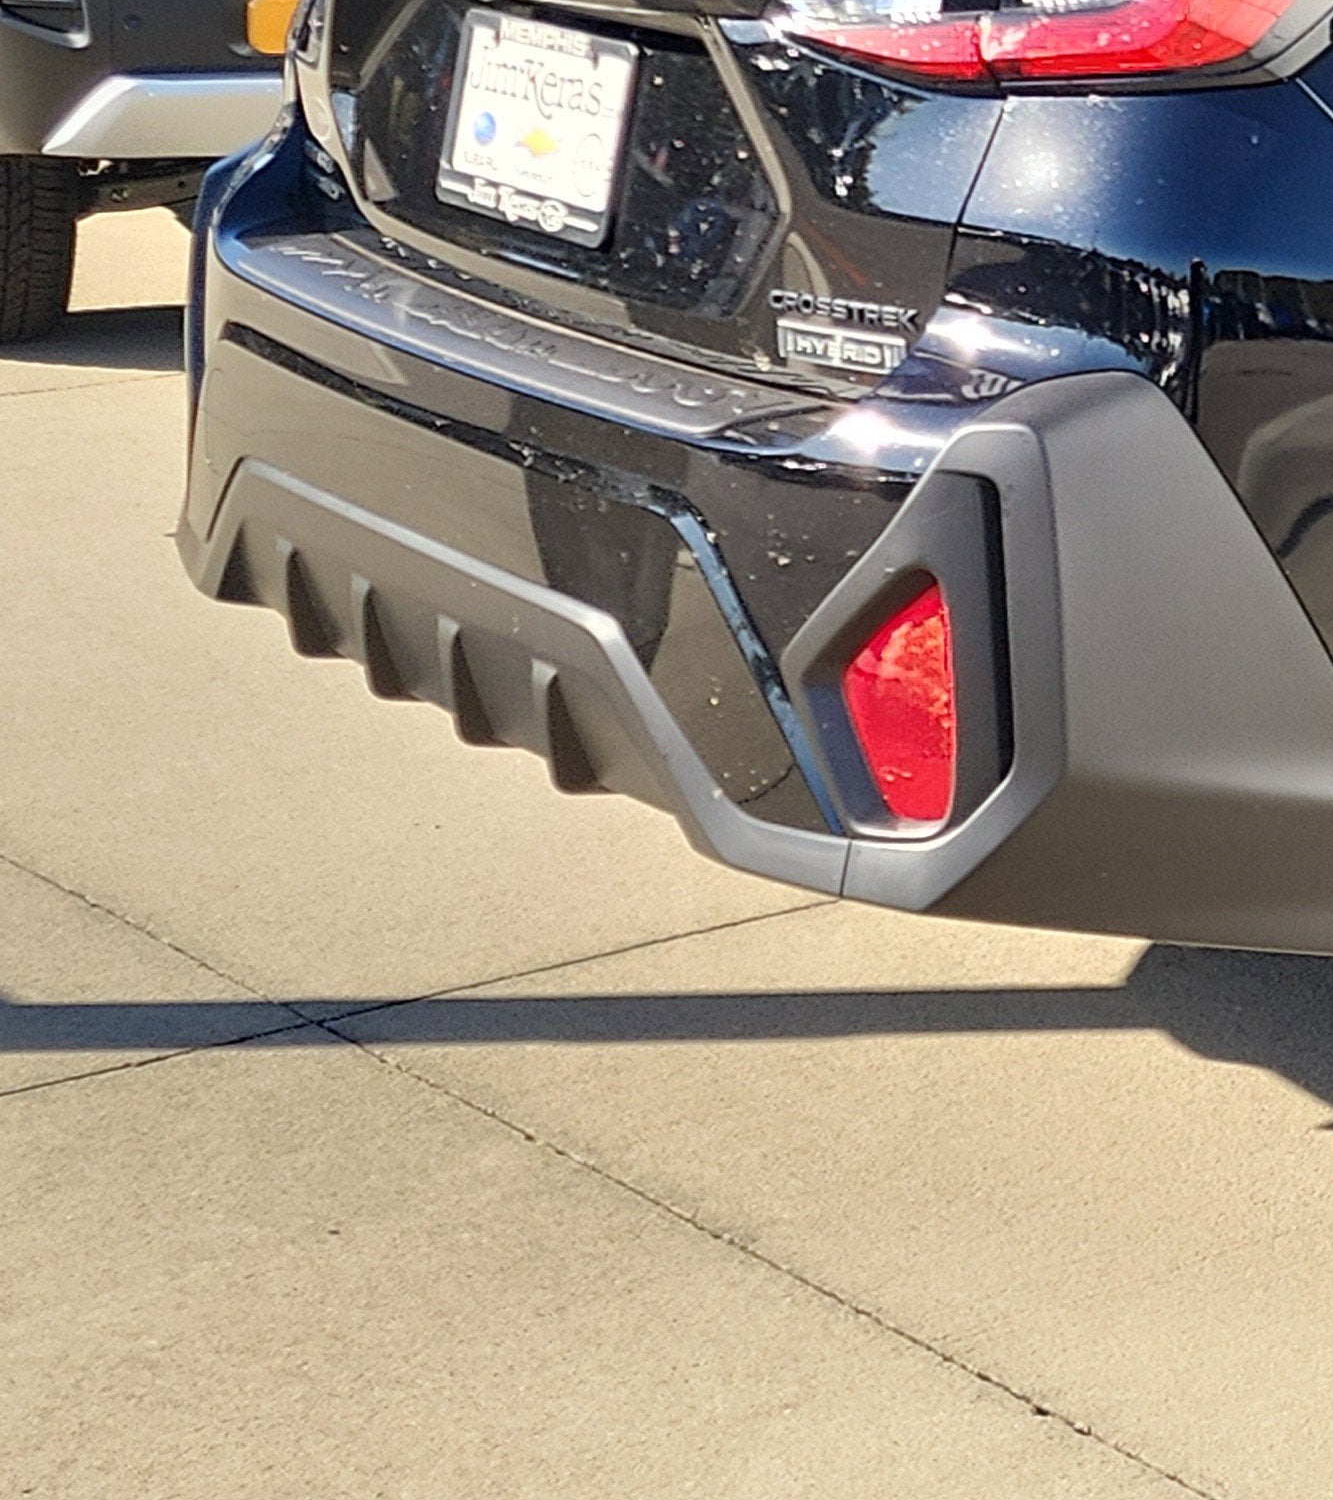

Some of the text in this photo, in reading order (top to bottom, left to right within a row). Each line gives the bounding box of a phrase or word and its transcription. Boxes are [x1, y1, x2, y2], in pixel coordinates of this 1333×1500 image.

[501, 17, 593, 59] MEMPHIS
[522, 59, 603, 119] Keras
[768, 289, 919, 333] CROSSTREK
[795, 334, 884, 365] HYBRID
